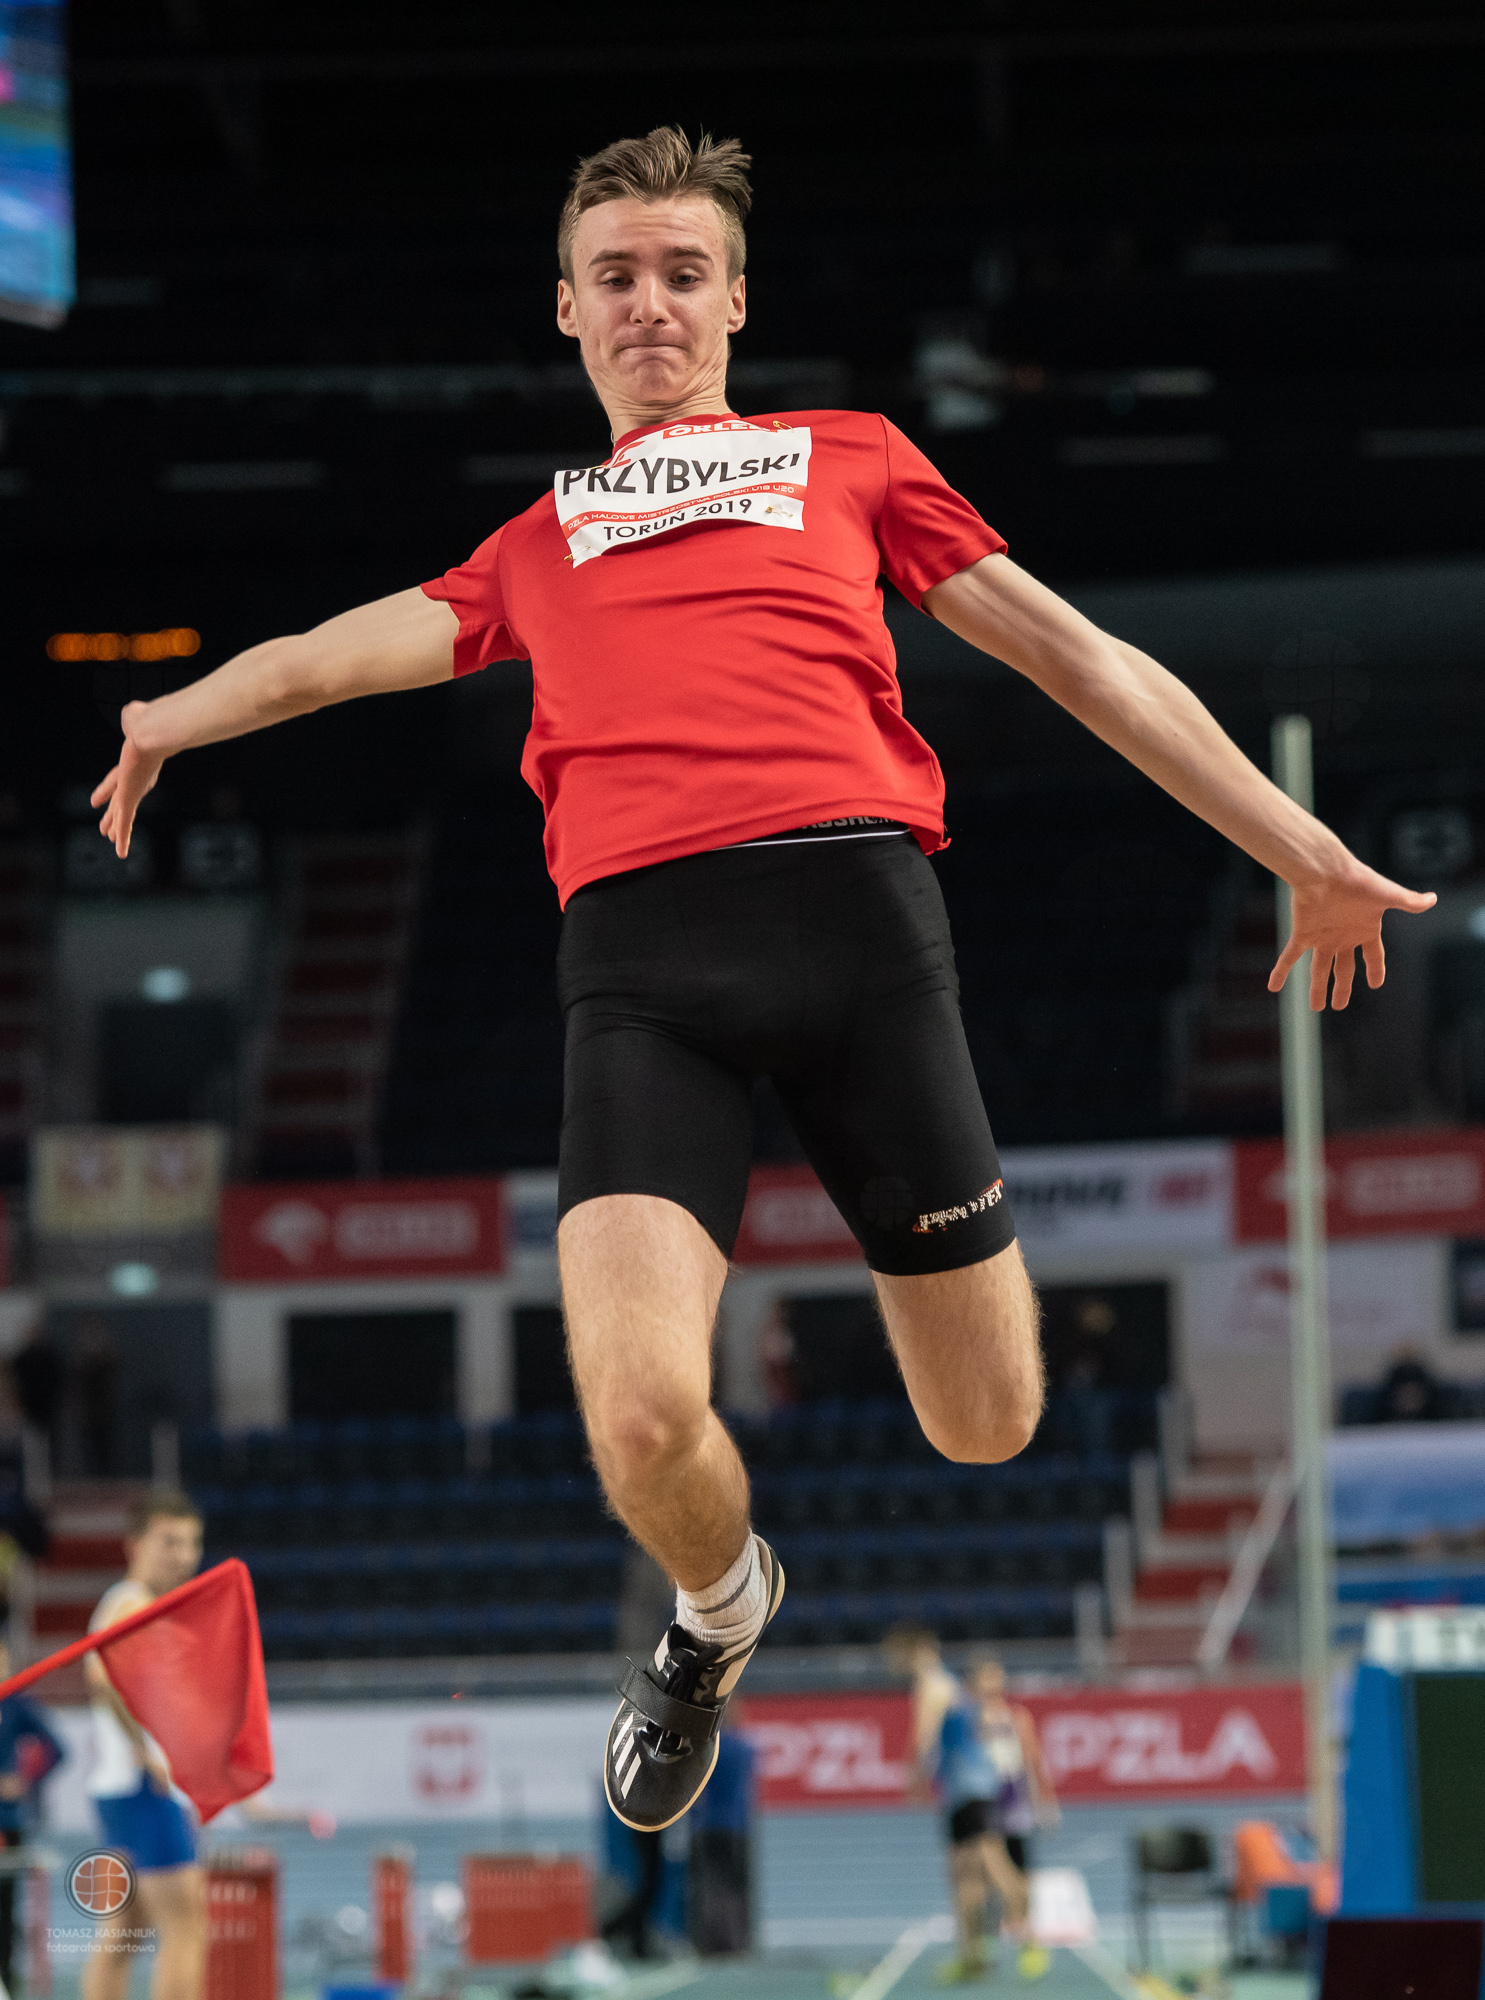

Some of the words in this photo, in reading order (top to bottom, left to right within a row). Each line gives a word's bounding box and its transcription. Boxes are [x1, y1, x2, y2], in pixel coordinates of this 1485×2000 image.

[562, 452, 800, 496] PRZYBYLSKI
[567, 515, 590, 532] PZLA
[591, 513, 636, 521] HALOWE
[637, 496, 711, 521] MISTRZOSTWA
[712, 487, 750, 500] POLSKI
[773, 484, 795, 494] U20
[603, 510, 686, 541] TORUŃ
[693, 498, 752, 518] 2019
[1039, 1707, 1279, 1786] PZLA
